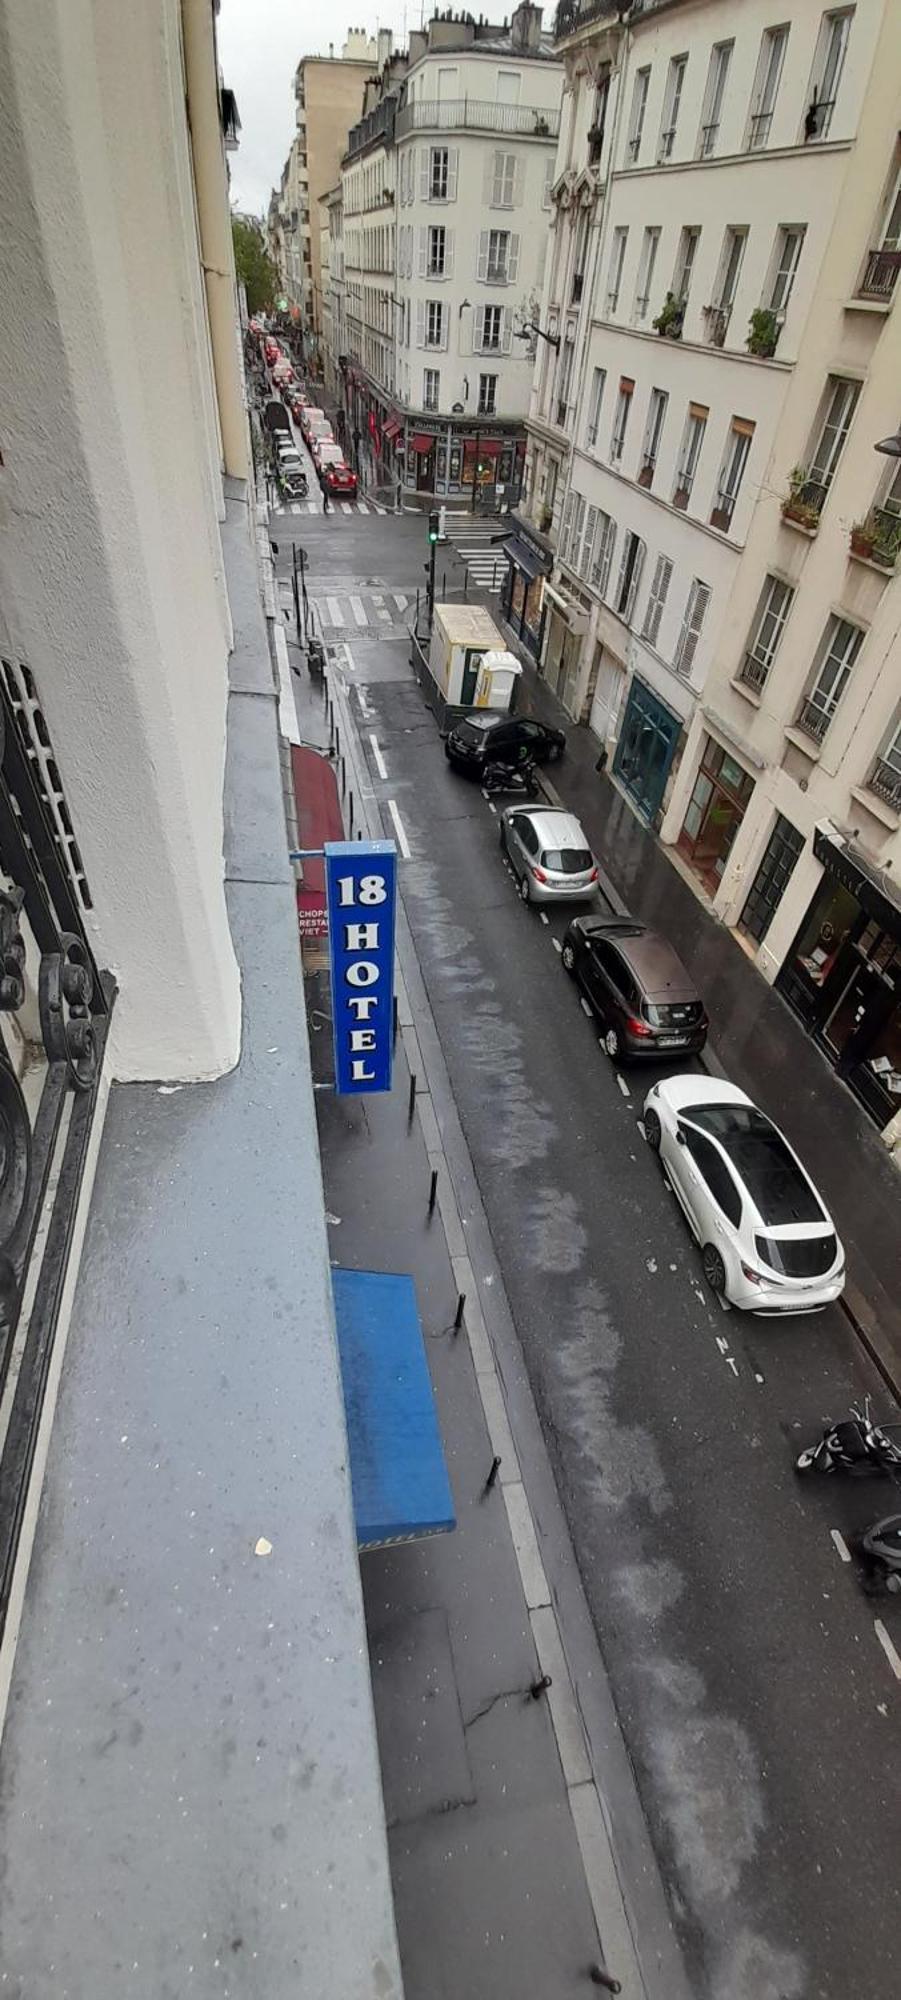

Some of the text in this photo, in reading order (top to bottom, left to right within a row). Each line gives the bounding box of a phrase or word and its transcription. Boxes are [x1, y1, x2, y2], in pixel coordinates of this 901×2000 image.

[338, 875, 387, 907] 18
[299, 919, 329, 927] RESTA
[299, 927, 320, 935] VIET
[345, 923, 380, 1080] HOTEL
